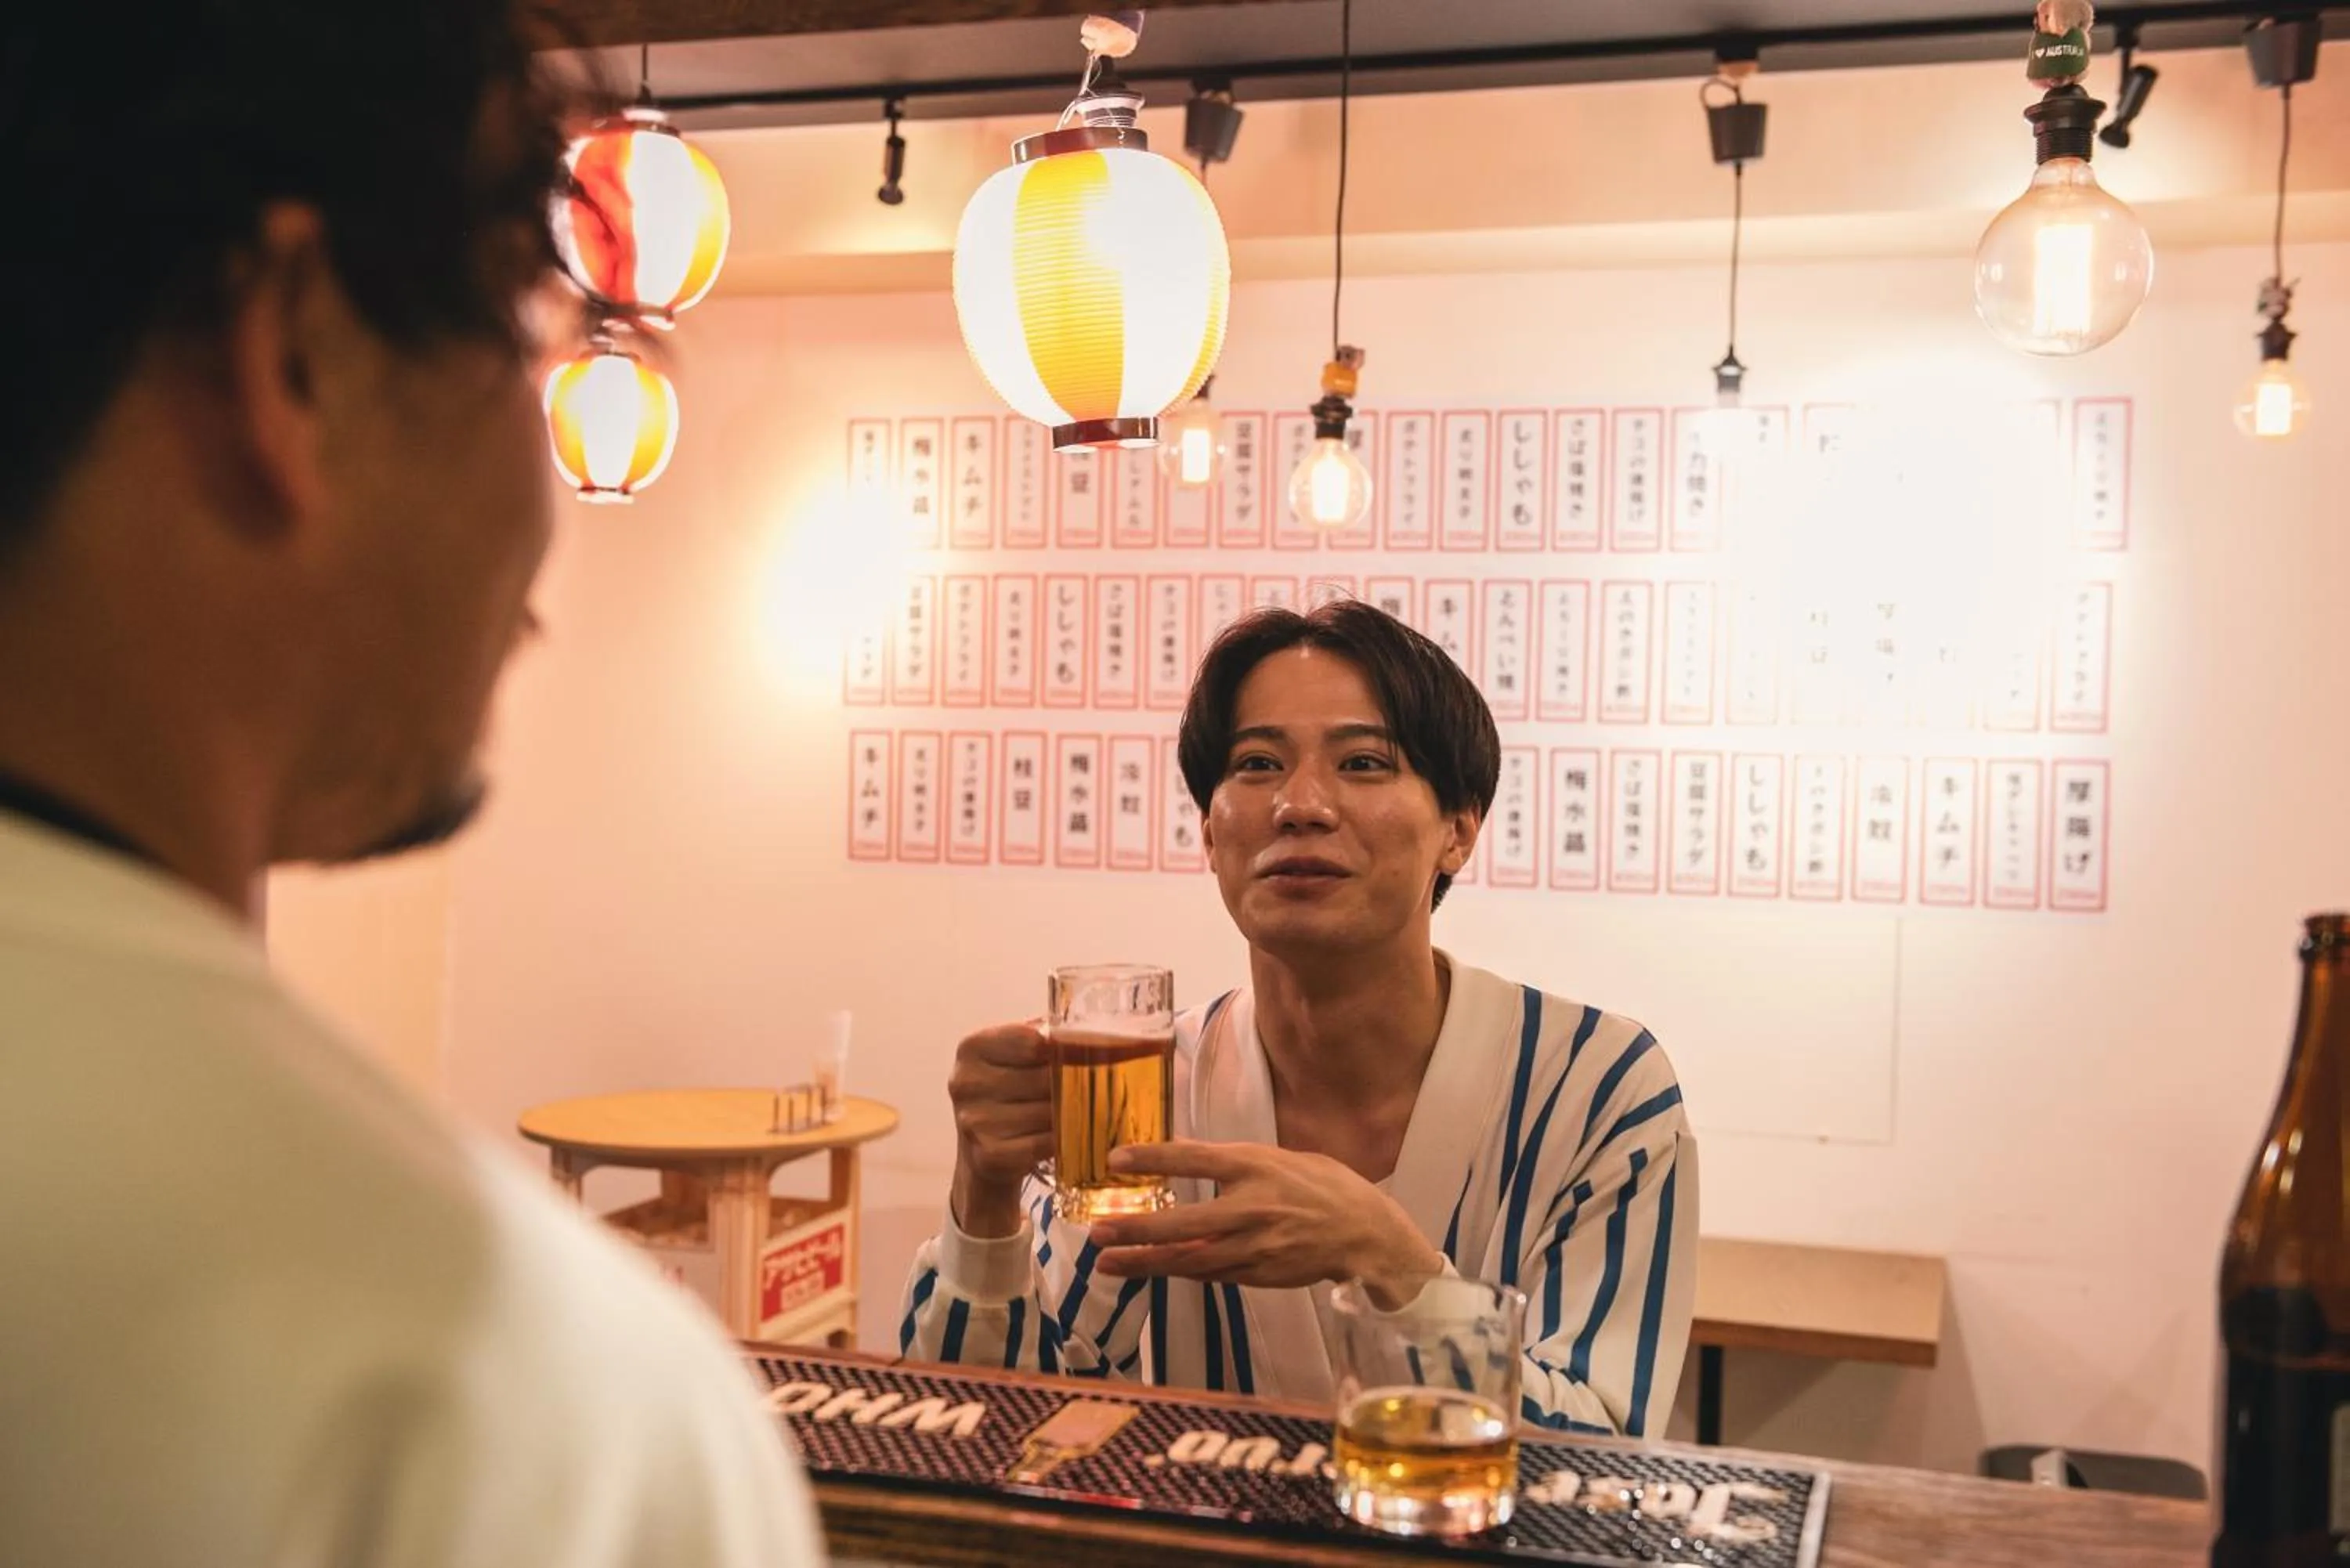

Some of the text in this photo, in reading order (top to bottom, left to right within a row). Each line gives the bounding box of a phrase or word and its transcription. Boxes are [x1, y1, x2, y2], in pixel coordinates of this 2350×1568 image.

[962, 434, 983, 518] キムチ
[1513, 419, 1534, 526] ししゃも
[1054, 583, 1076, 685] ししゃも
[861, 746, 880, 830] キムチ
[1067, 752, 1090, 835] 梅水晶
[1175, 771, 1194, 847] しゃも
[1563, 768, 1588, 855] 梅水晶
[1686, 761, 1708, 868] 豆腐サラダ
[1744, 764, 1770, 873] ししゃも
[1935, 775, 1961, 872] キムチ
